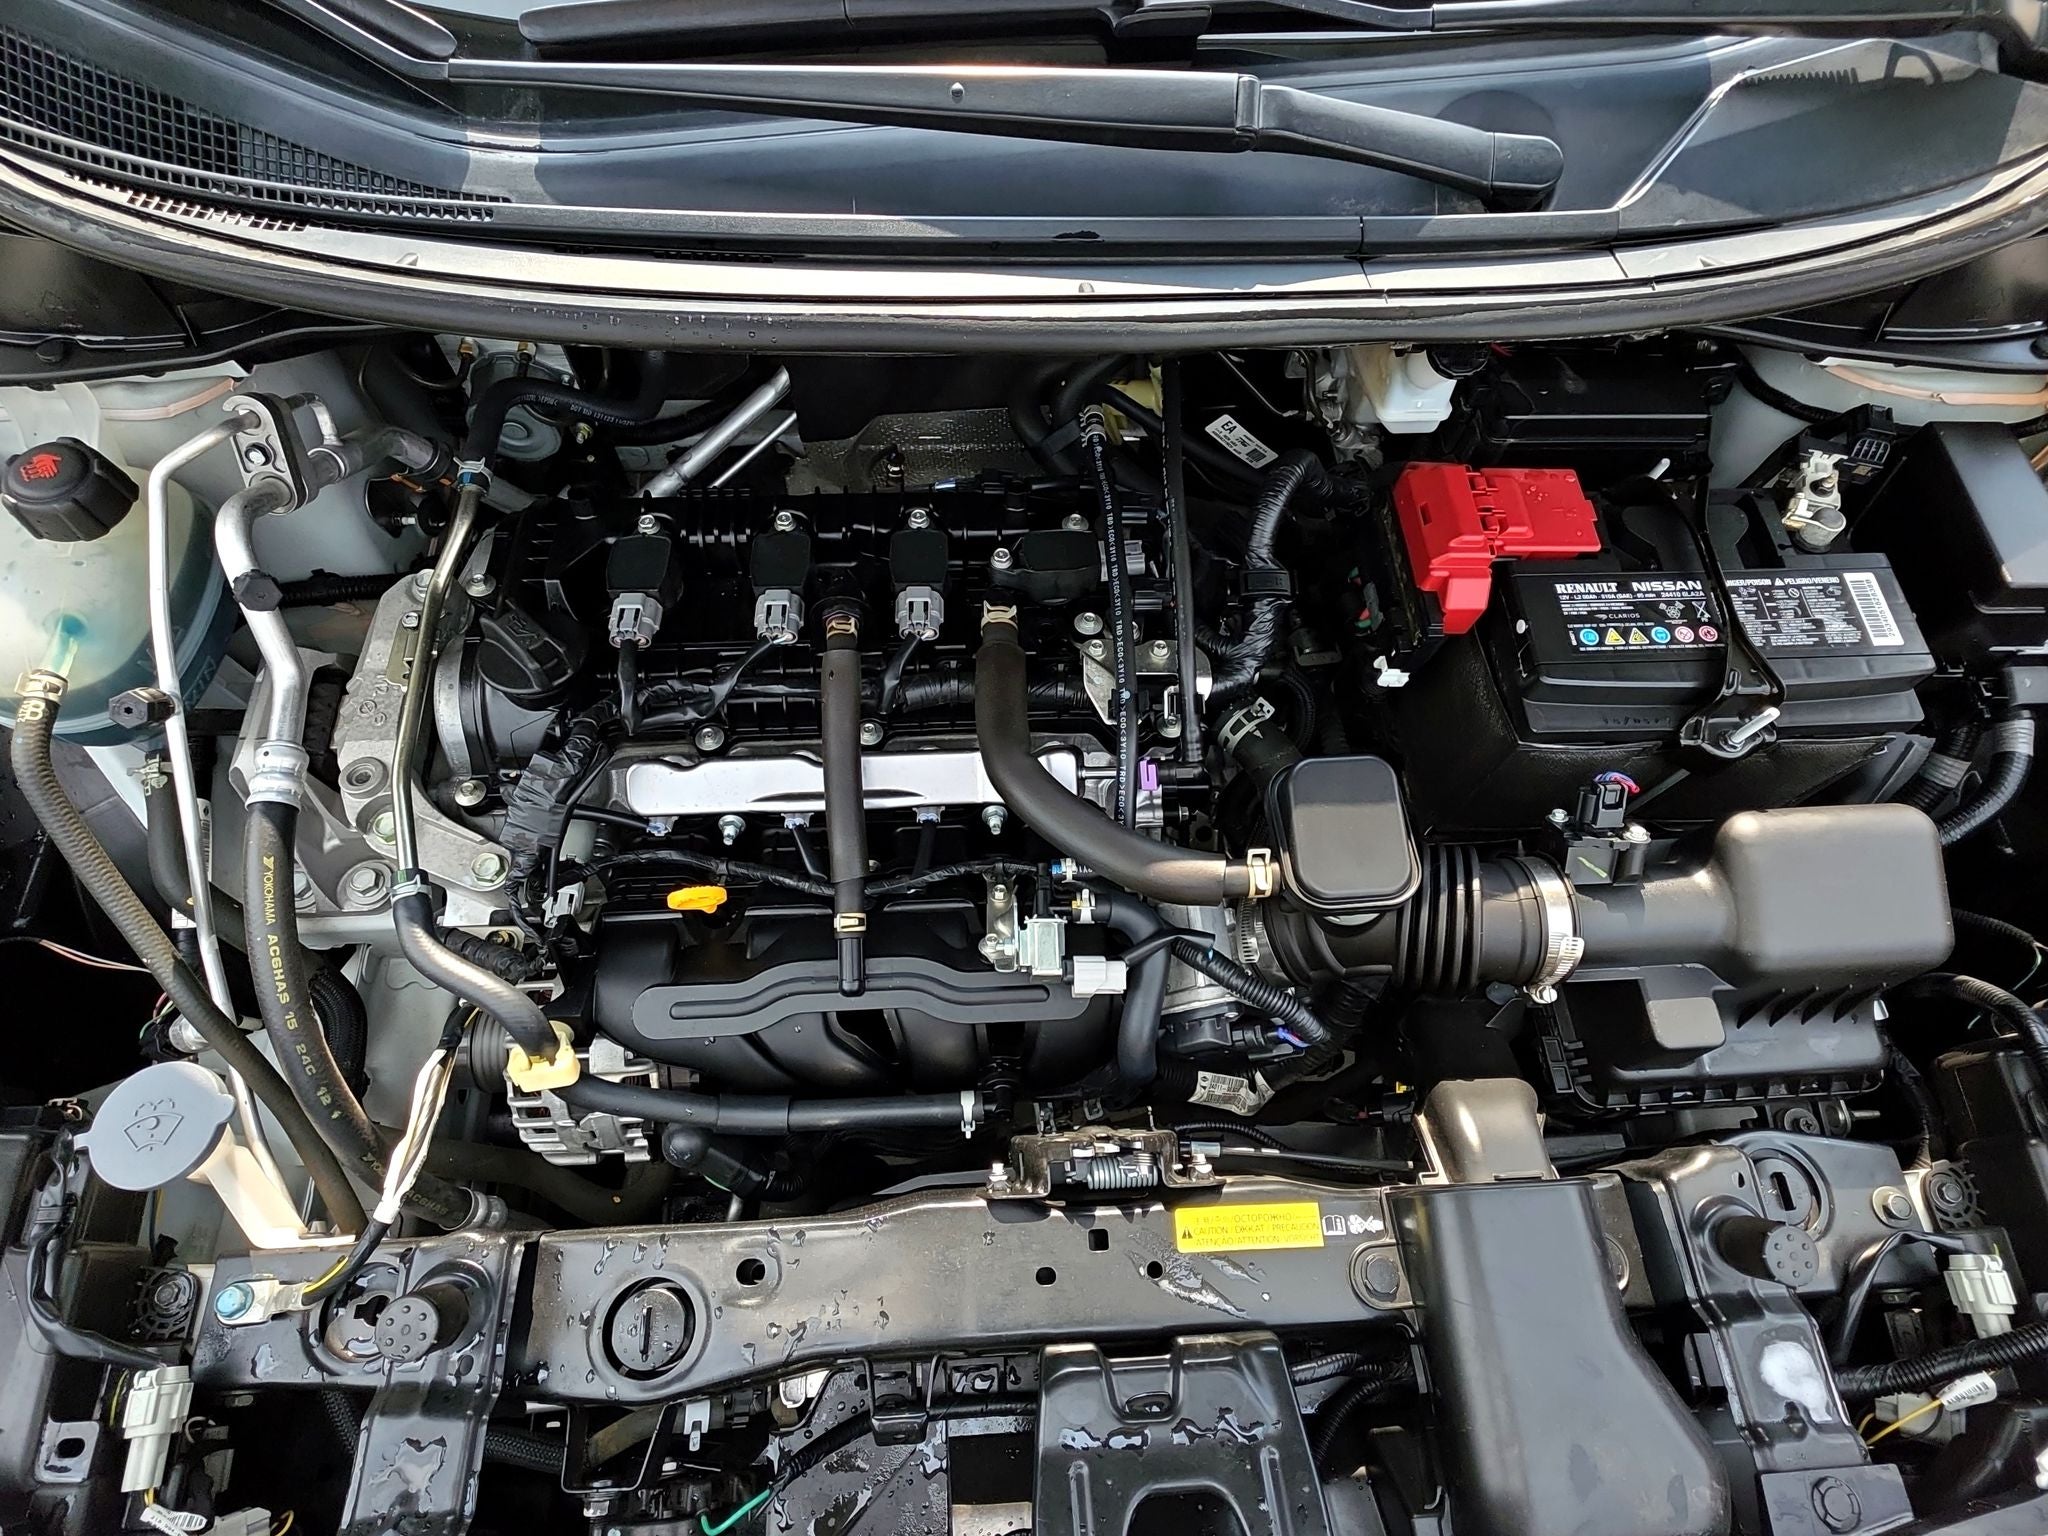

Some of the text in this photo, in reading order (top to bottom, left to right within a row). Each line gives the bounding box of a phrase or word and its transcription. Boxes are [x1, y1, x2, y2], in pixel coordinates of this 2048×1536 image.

[1220, 420, 1237, 435] EA
[1554, 580, 1703, 594] RENAULT NISSAN
[1784, 576, 1840, 585] PELIGRO/VENENO
[263, 870, 276, 926] YOKOHAMA
[267, 934, 290, 1005] AC6HAS
[284, 1011, 299, 1031] 15
[295, 1043, 317, 1076] 24C
[1193, 1226, 1229, 1236] CAUTION
